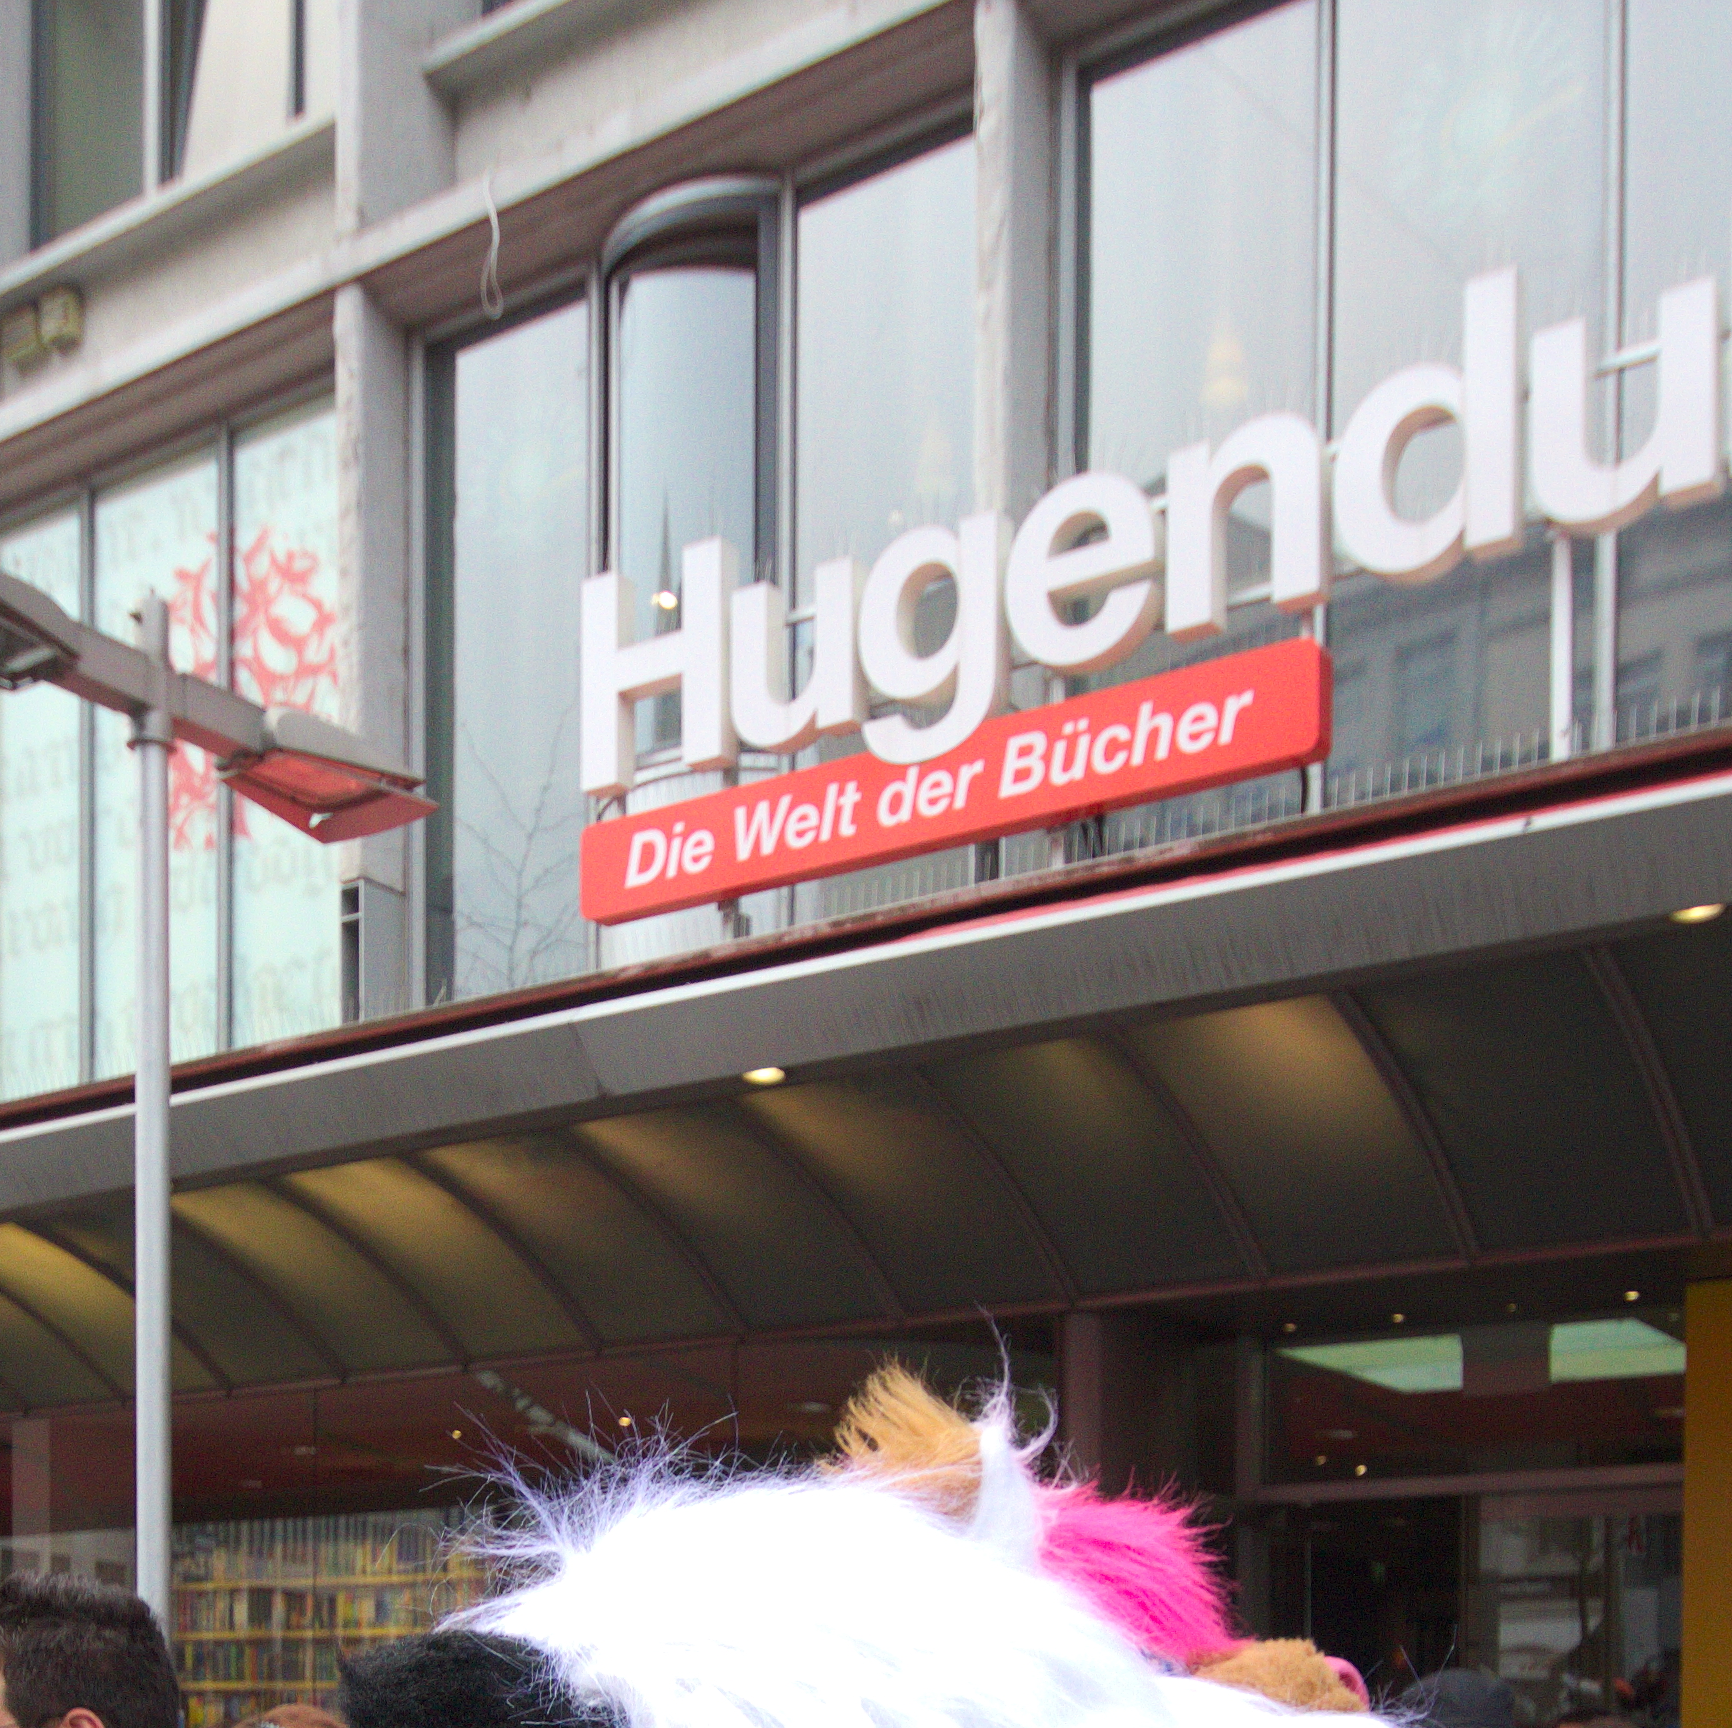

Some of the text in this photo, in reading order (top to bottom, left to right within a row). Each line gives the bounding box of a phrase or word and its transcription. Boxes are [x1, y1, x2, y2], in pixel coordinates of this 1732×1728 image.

[625, 690, 1254, 888] Die Welt der Bücher
